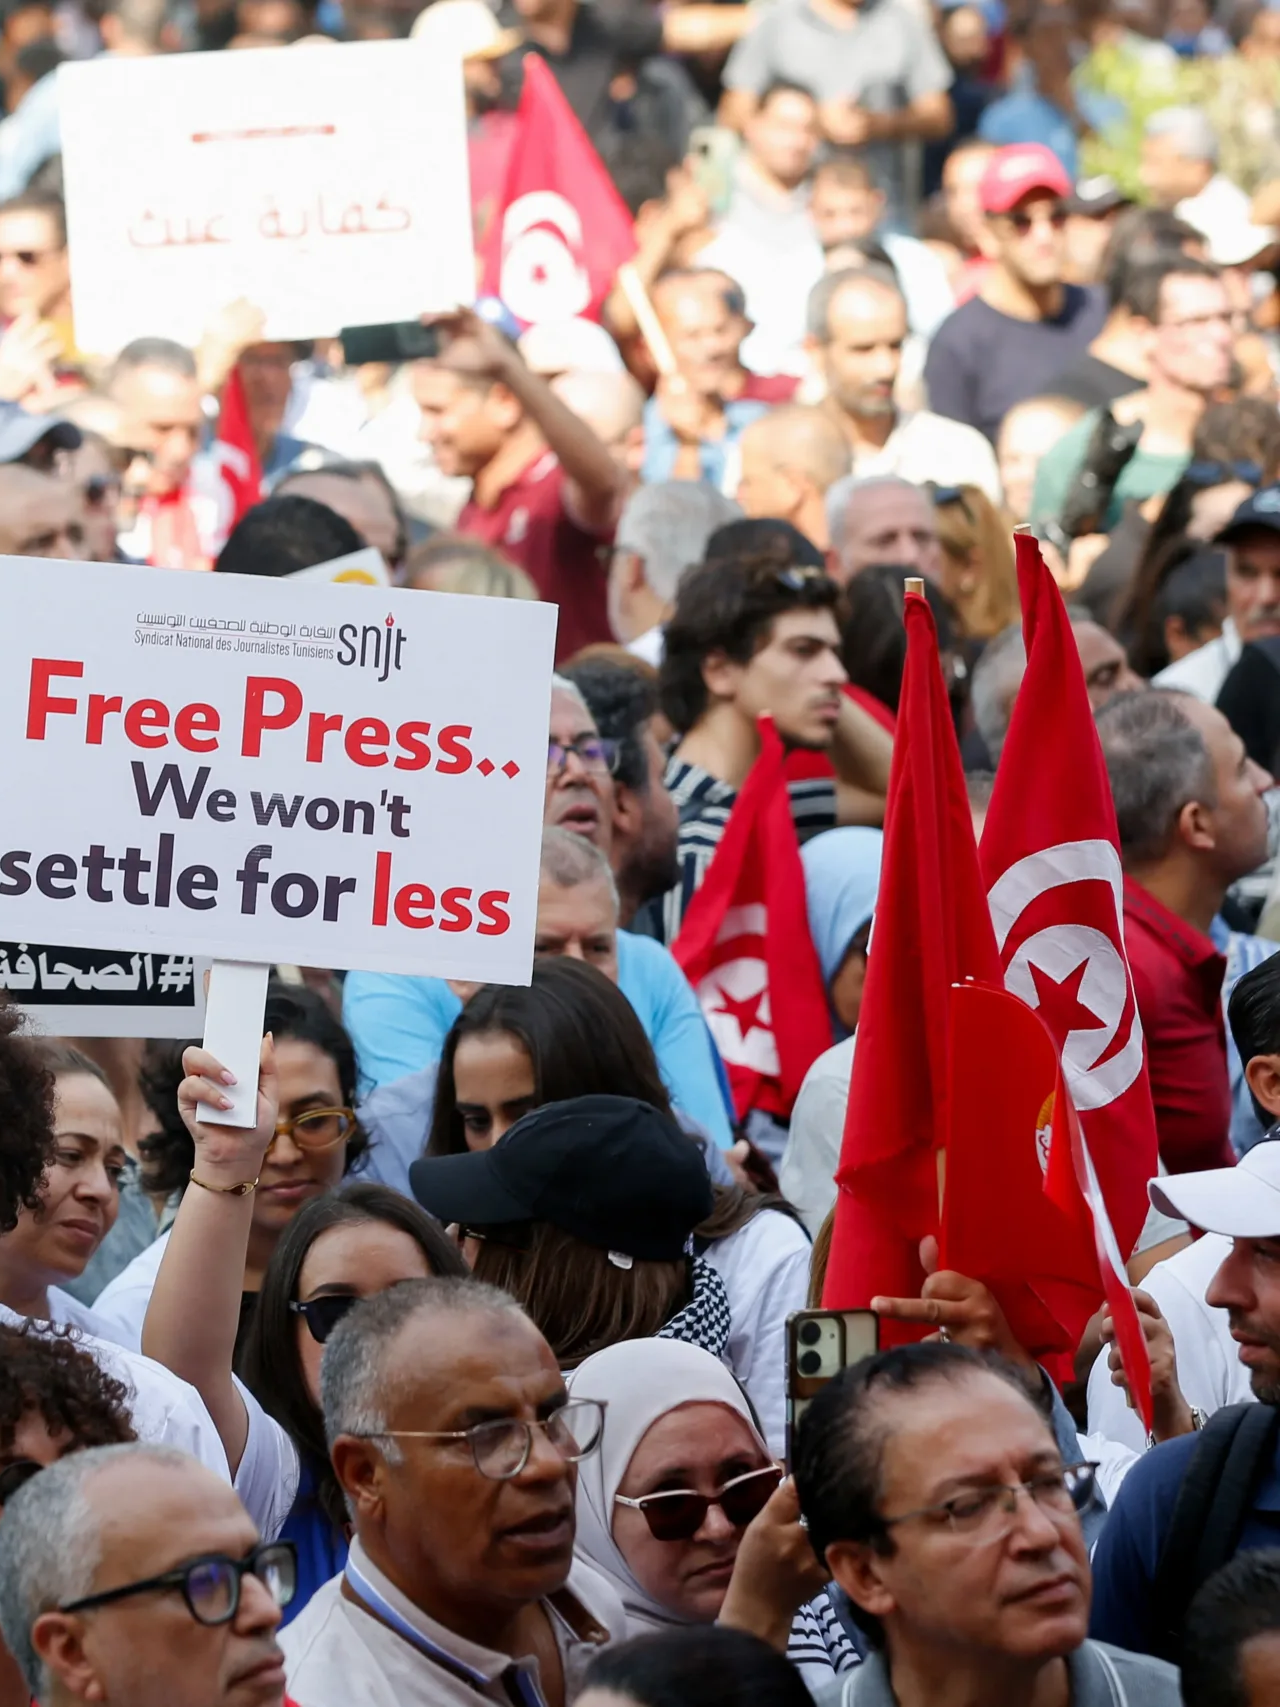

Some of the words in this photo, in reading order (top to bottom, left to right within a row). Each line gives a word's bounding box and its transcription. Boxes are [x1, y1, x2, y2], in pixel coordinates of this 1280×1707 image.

[257, 191, 413, 254] كفاية
[136, 611, 186, 628] التونسيين
[189, 616, 246, 632] للصحفيين
[249, 620, 296, 638] الوطنية
[299, 624, 336, 641] النقابة
[134, 629, 174, 647] Syndicat
[175, 633, 214, 650] National
[215, 637, 232, 652] des
[233, 638, 290, 657] Journalistes
[292, 643, 334, 660] Tunisiens
[336, 612, 407, 682] snjt
[25, 658, 221, 753] Free
[240, 675, 521, 779] Press..
[130, 760, 237, 823] We
[249, 788, 412, 838] won't
[236, 844, 357, 923] for
[371, 851, 511, 937] less
